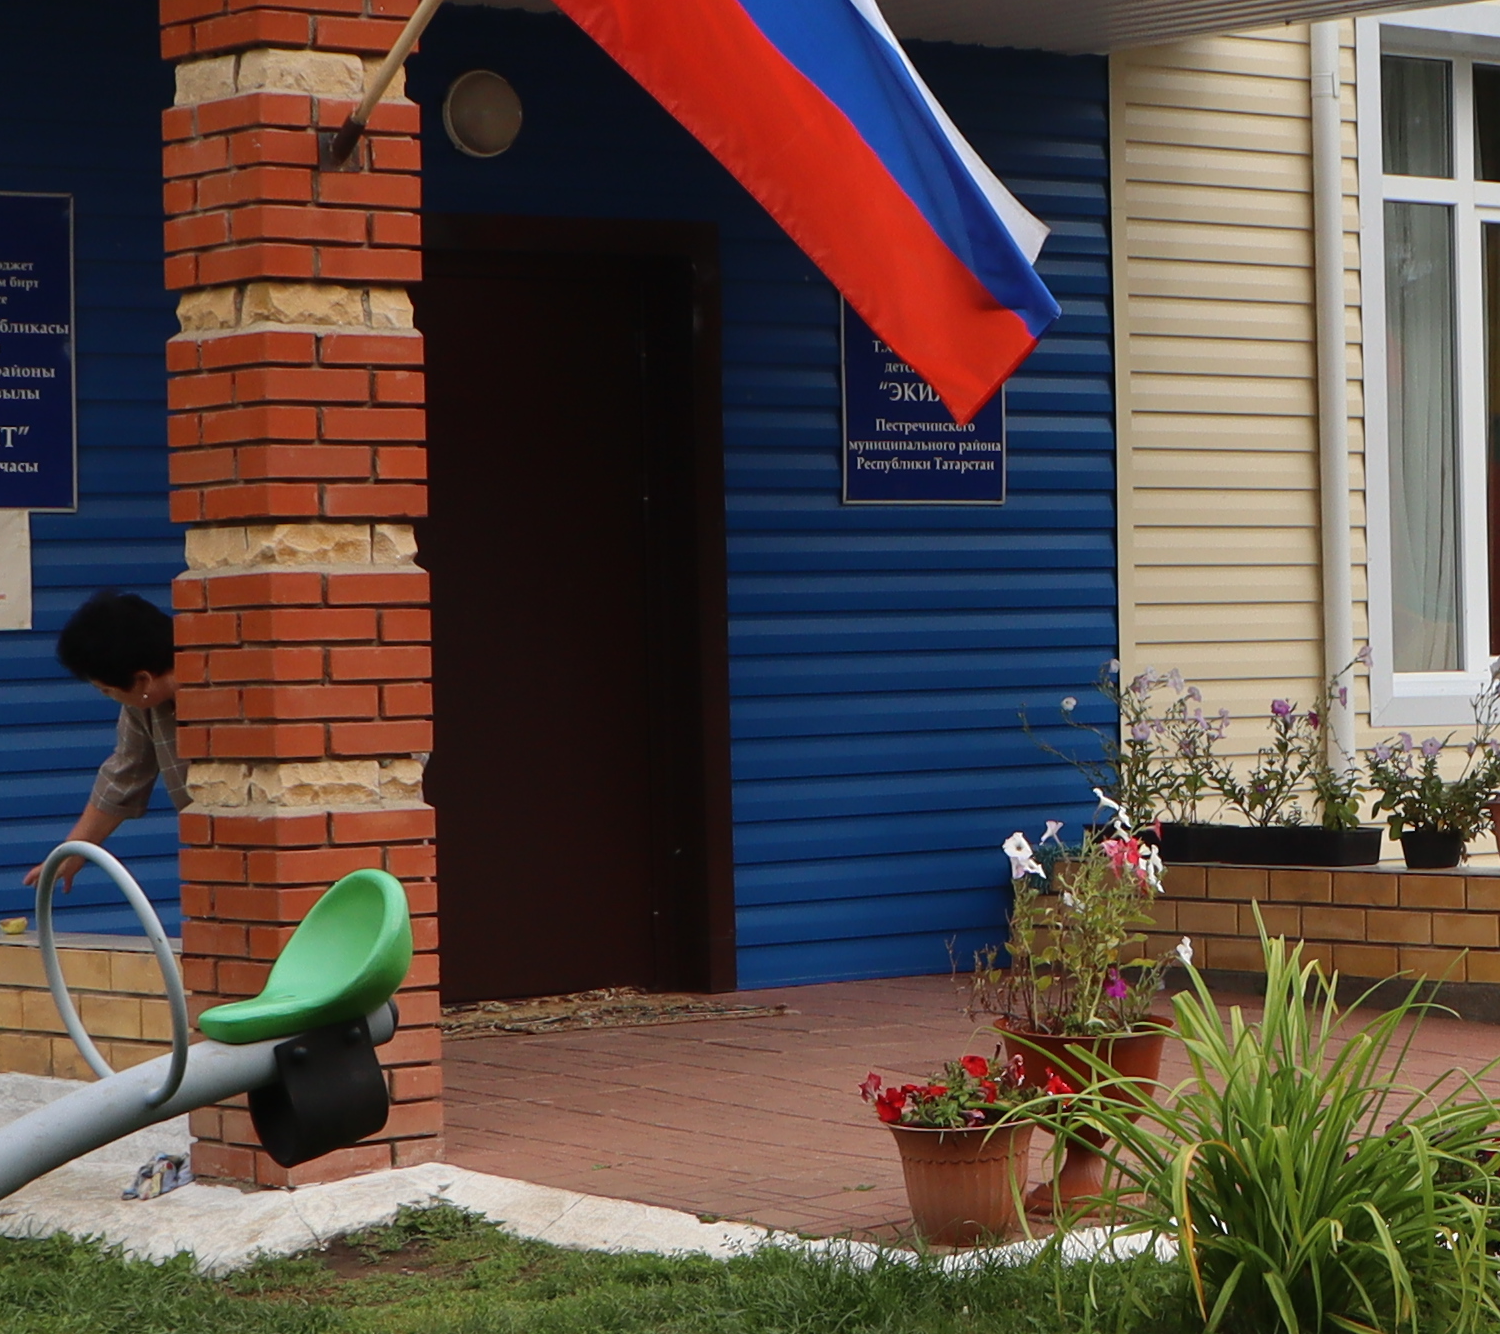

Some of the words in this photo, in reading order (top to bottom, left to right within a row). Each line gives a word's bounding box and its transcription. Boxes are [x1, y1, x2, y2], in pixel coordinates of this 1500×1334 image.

[875, 419, 975, 435] Пестречинского
[849, 440, 956, 454] муниципального
[959, 439, 1001, 454] района
[857, 457, 931, 473] Республики
[933, 457, 995, 473] Татарстан
